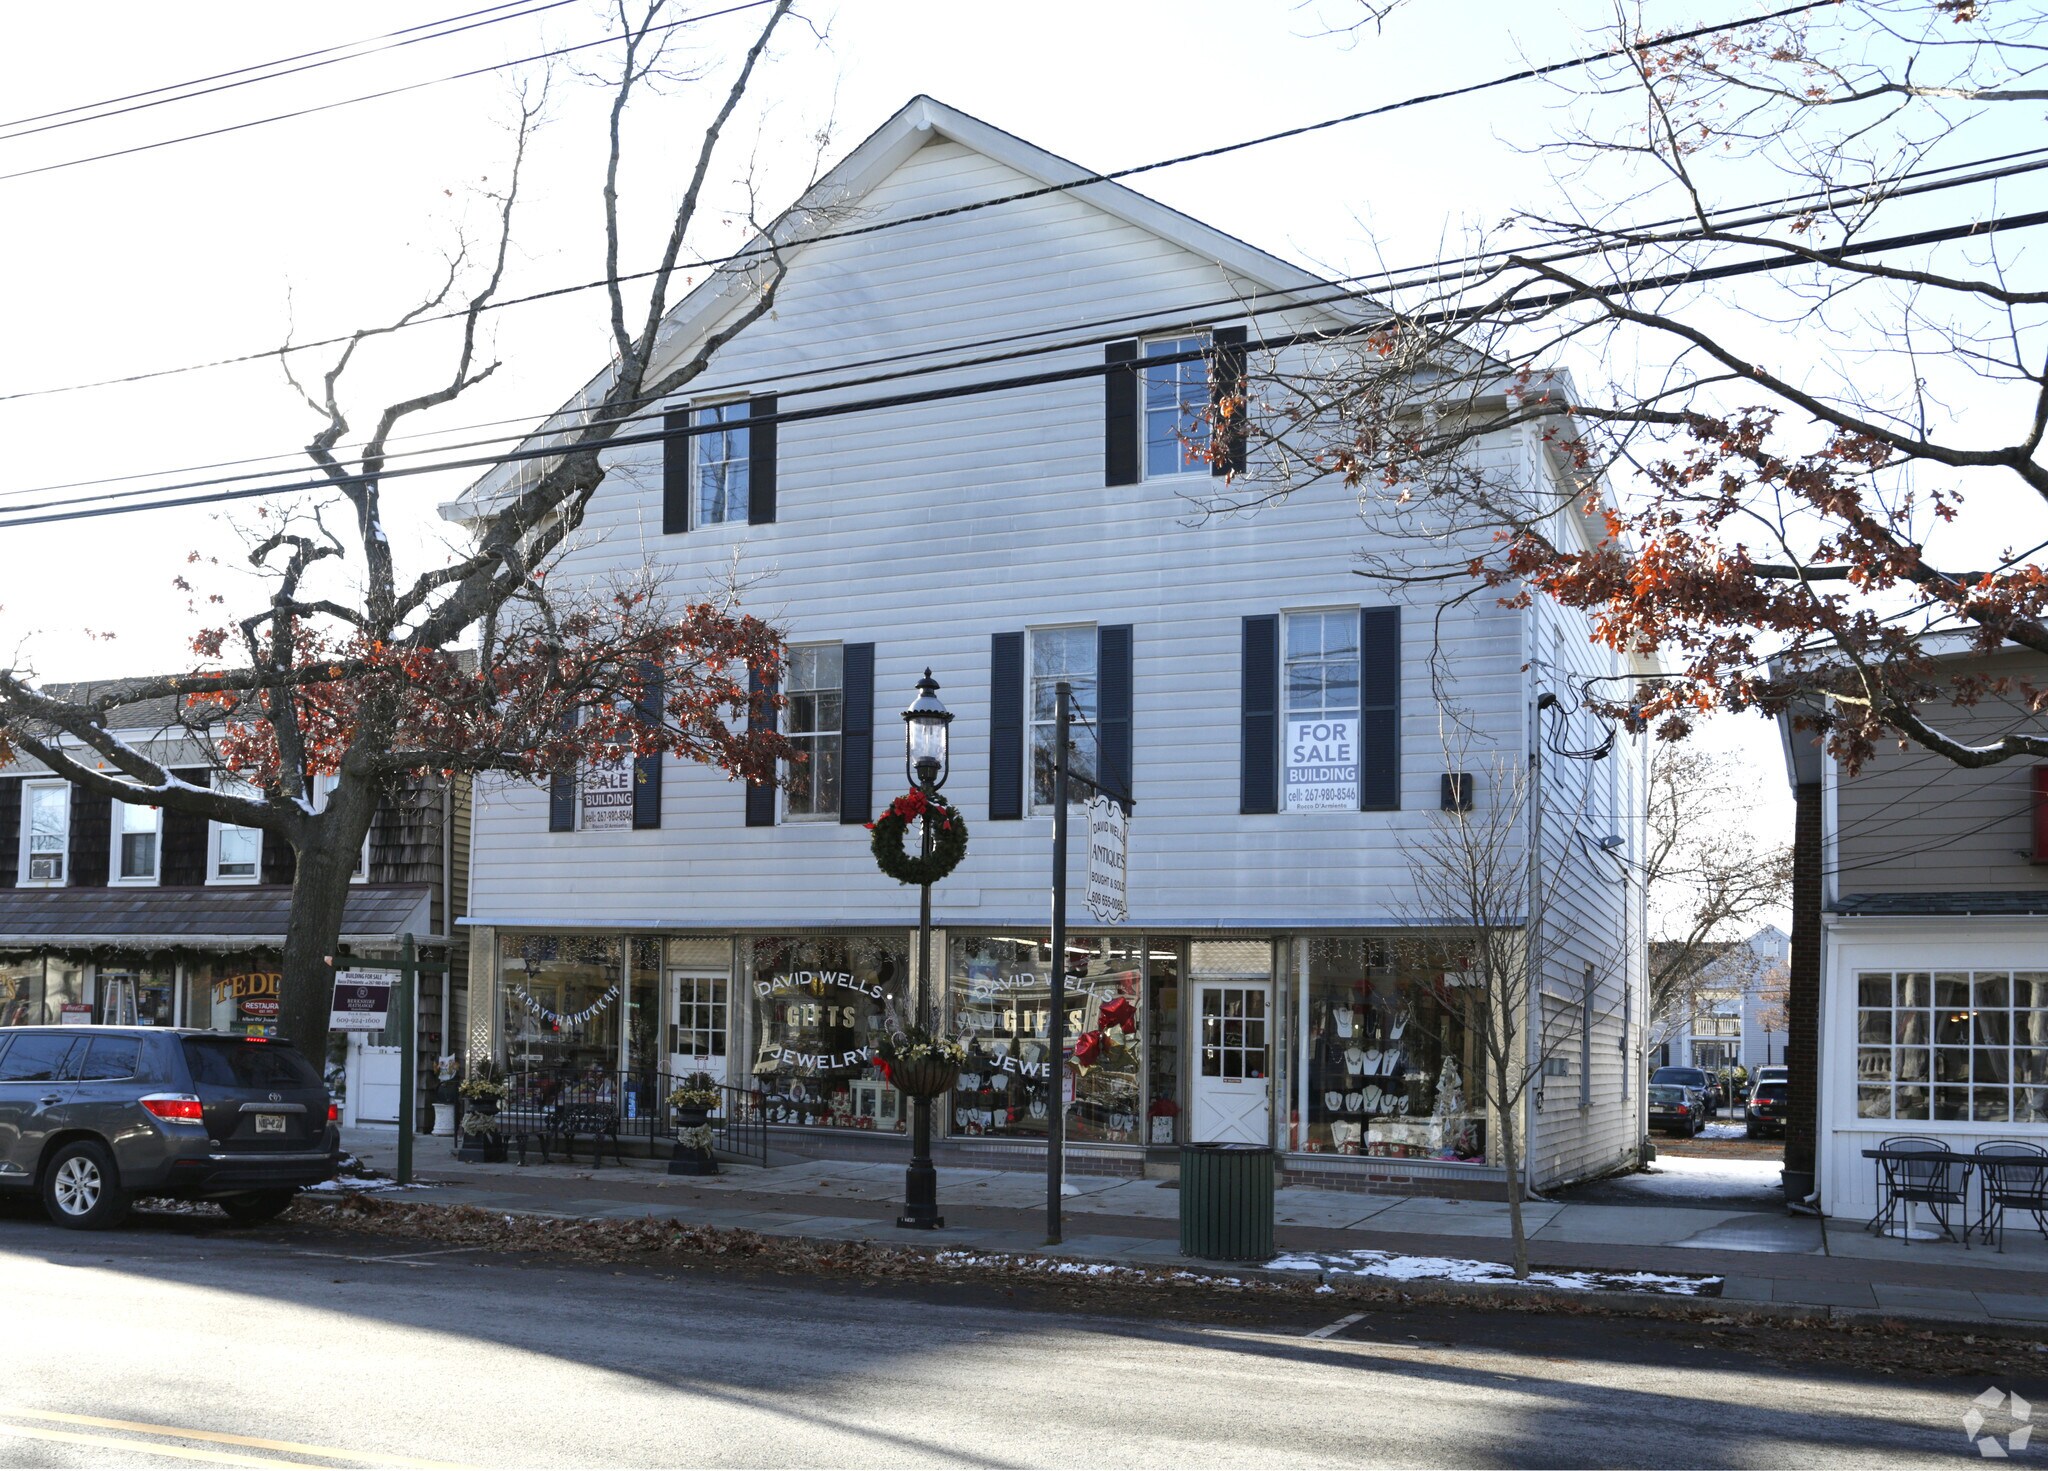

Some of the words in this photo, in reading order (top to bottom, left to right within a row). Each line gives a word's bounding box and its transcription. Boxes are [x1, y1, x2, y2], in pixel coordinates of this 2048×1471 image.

[1299, 723, 1347, 742] FOR
[1293, 744, 1351, 764] SALE
[1289, 767, 1356, 782] BUILDING
[586, 793, 632, 806] BUILDING
[1288, 788, 1303, 802] cell:
[1305, 787, 1356, 802] 267-980-8546
[1092, 821, 1109, 835] DAVID
[1091, 844, 1125, 870] ANTIQUES
[1091, 871, 1110, 887] BOUGHT
[1109, 878, 1114, 889] &
[1113, 879, 1125, 892] SOLD
[1091, 891, 1102, 905] 609
[757, 971, 813, 997] DAVID
[819, 970, 884, 999] WELLS
[974, 972, 1035, 1000] DAVID
[513, 983, 549, 1020] HAPPY
[555, 984, 620, 1027] HANUKKAH
[786, 1004, 856, 1028] GIFTS
[1003, 1009, 1083, 1033] GIFS
[770, 1046, 869, 1070] JEWELRY
